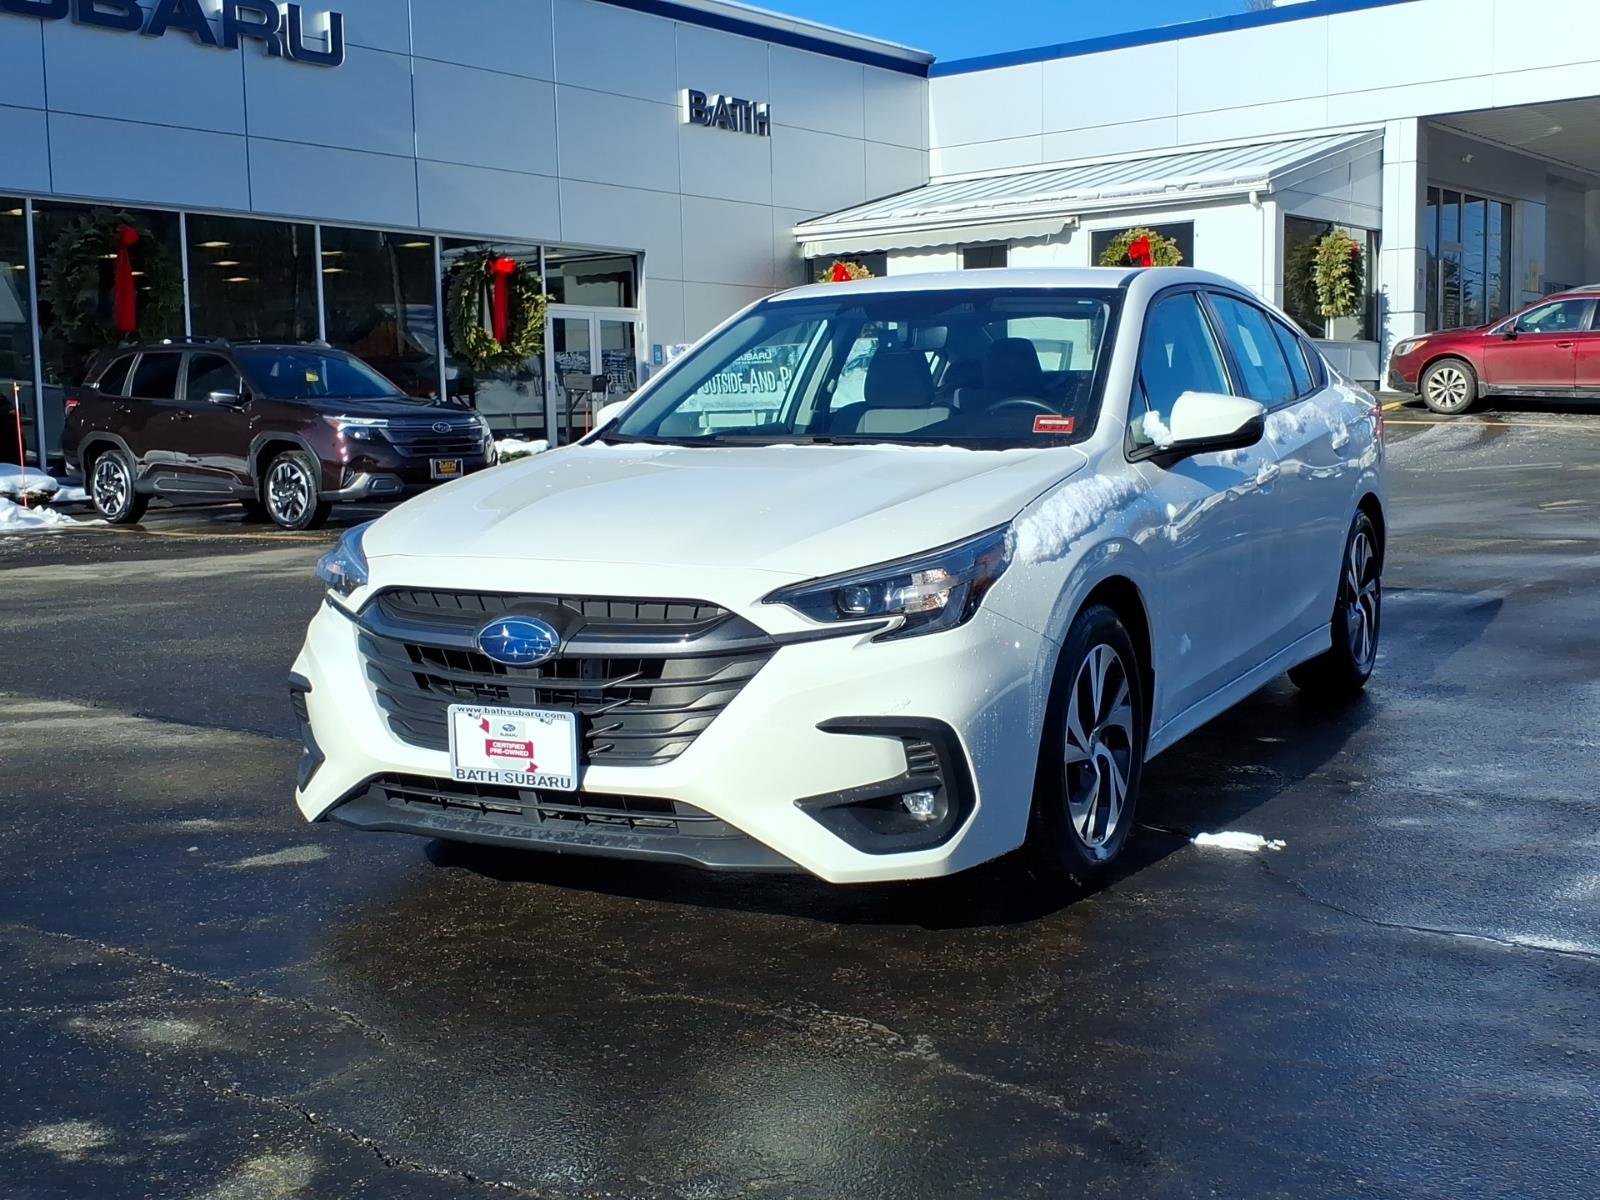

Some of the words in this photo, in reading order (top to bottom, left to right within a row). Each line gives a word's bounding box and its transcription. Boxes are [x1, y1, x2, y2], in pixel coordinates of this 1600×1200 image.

[682, 88, 770, 136] BATH
[457, 705, 566, 720] www.bathsubaru.com
[489, 747, 529, 757] PRE-OWNED
[492, 741, 526, 750] CERTIFIED
[456, 768, 499, 782] BATH
[504, 772, 571, 789] SUBARU
